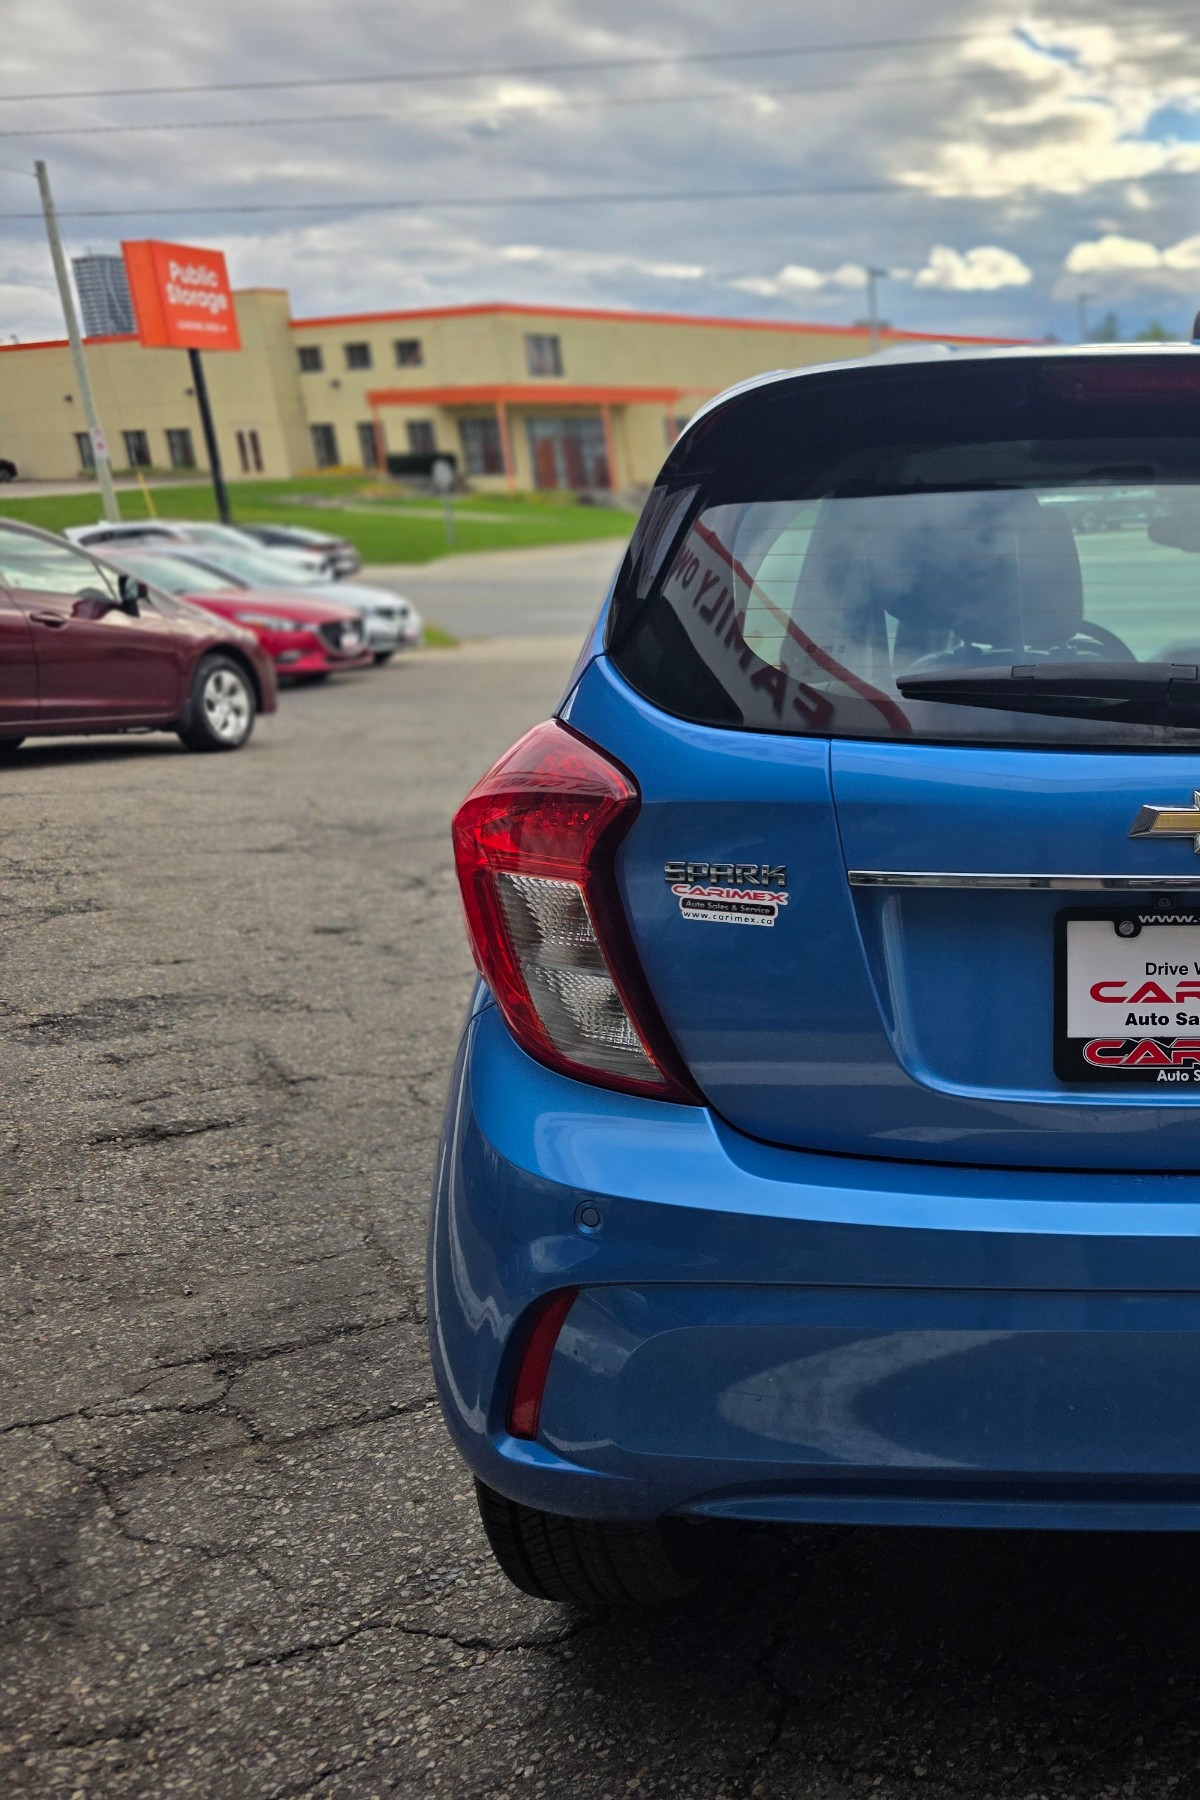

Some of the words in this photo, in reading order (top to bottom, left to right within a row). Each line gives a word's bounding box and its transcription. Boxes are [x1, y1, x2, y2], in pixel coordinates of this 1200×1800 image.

[168, 260, 219, 287] Public
[166, 283, 228, 315] Storage
[664, 861, 787, 886] SPARK
[672, 885, 786, 903] CARIMEX
[686, 900, 705, 910] Auto
[707, 902, 729, 912] Sales
[731, 904, 738, 912] &
[740, 905, 771, 915] Service
[683, 911, 773, 925] www.carimex.ca
[1145, 962, 1189, 976] Drive
[1125, 1012, 1170, 1026] Auto
[1157, 1069, 1189, 1081] Auto
